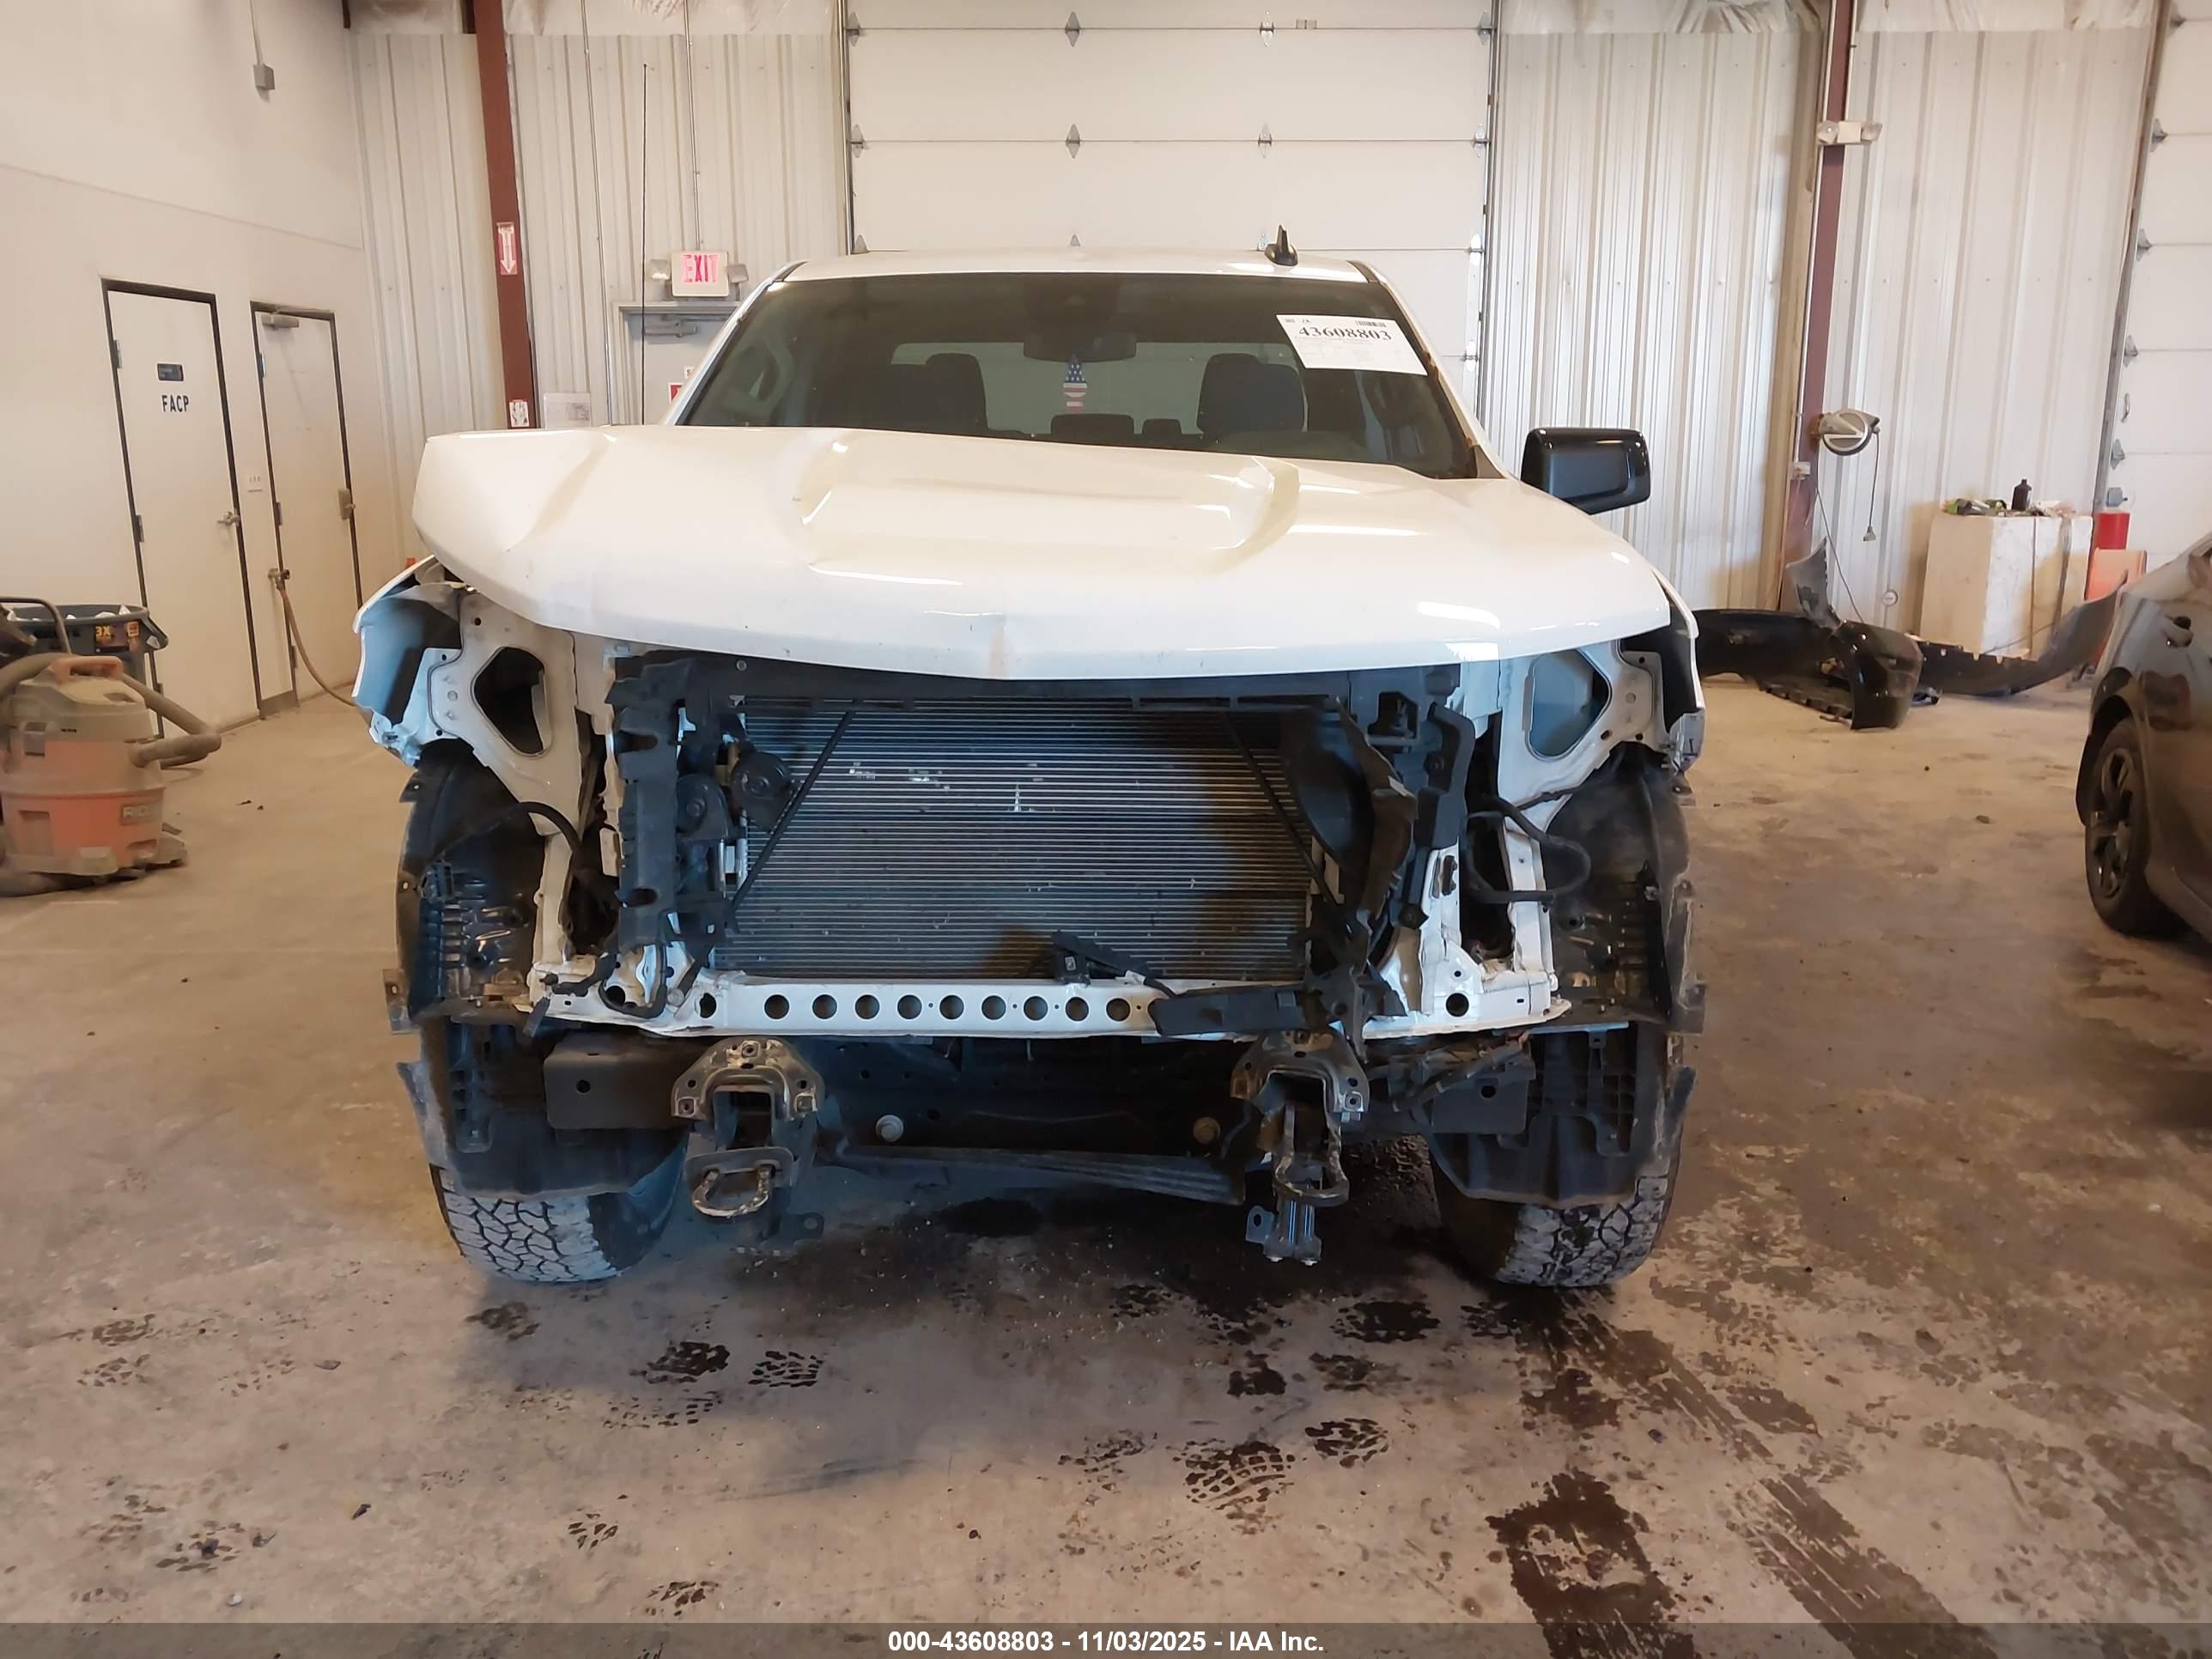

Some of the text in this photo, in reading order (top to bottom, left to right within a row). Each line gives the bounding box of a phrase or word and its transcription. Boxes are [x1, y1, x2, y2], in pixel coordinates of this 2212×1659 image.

[682, 254, 719, 283] EXIT
[1298, 326, 1392, 341] 43608803
[161, 394, 189, 412] FACP
